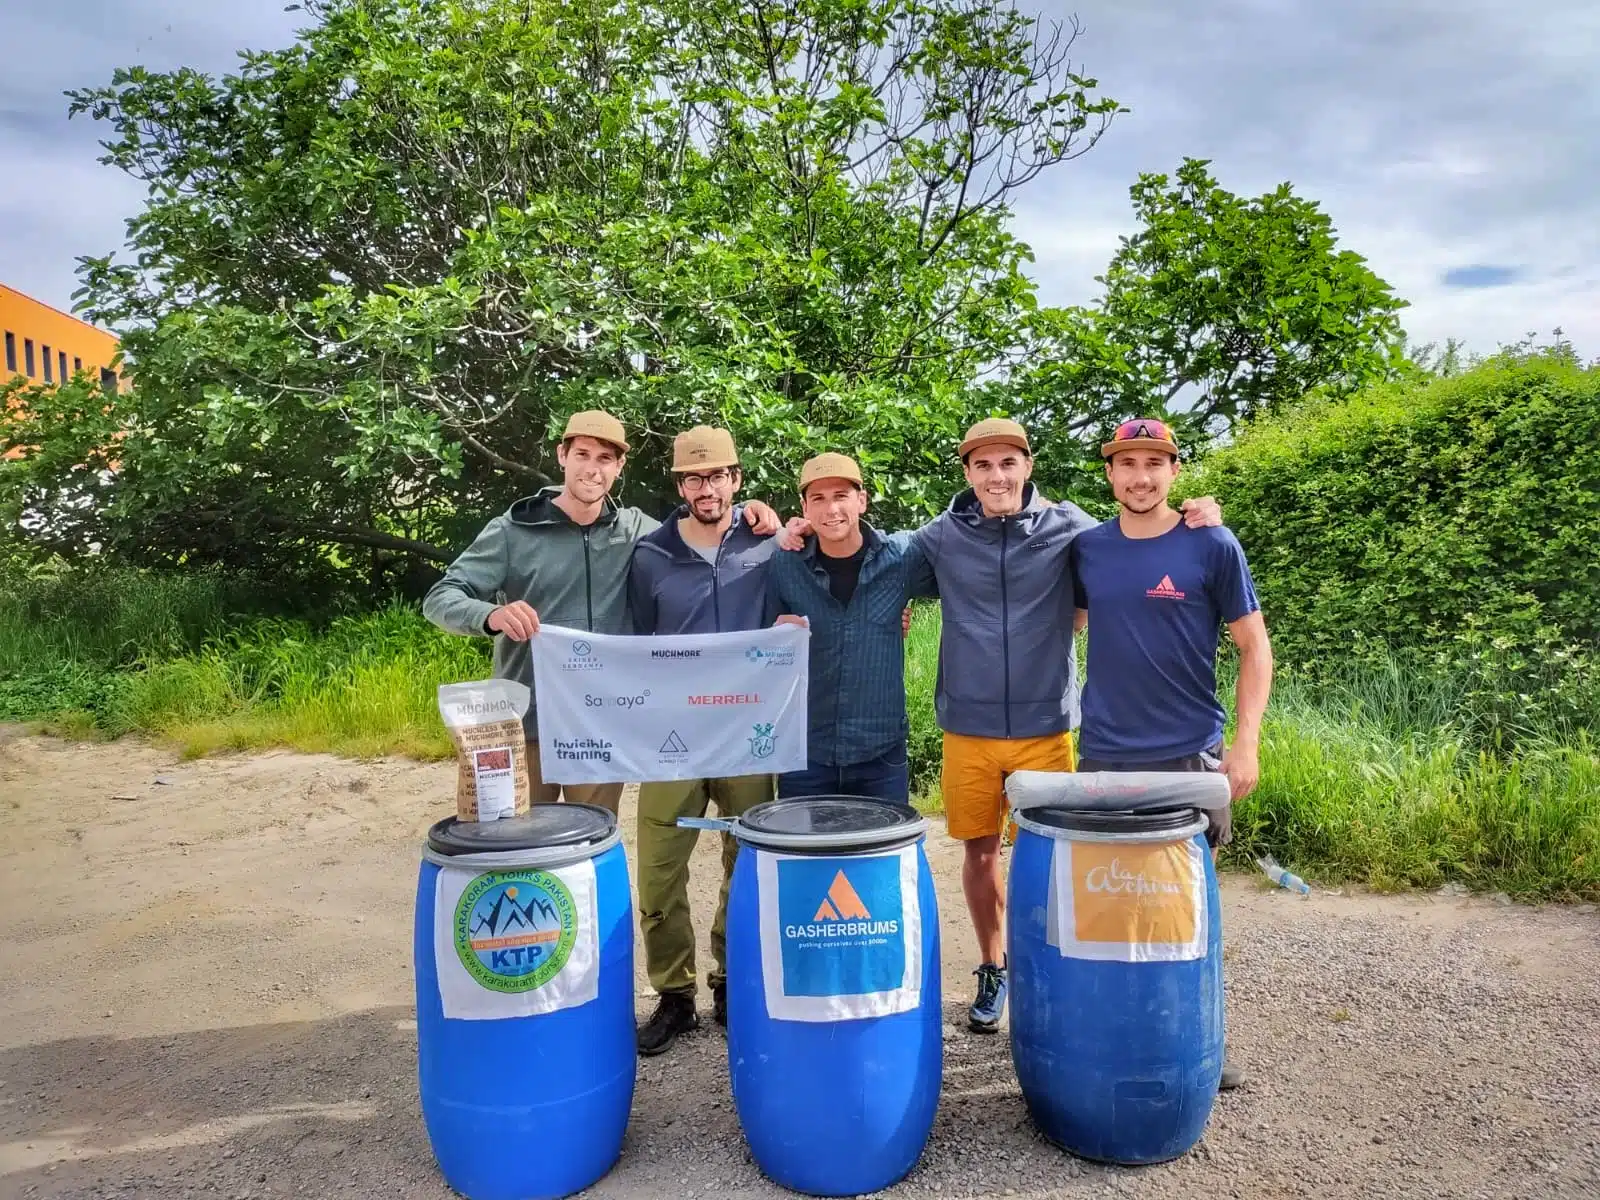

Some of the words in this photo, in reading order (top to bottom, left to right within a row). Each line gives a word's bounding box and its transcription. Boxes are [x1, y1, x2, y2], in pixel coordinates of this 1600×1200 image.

[651, 649, 701, 658] MUCHMORE
[688, 692, 761, 705] MERRELL
[556, 748, 611, 762] training
[458, 875, 497, 943] KARAKORAM
[501, 871, 541, 883] TOURS
[543, 877, 573, 930] PAKISTAN
[785, 920, 898, 938] GASHERBRUMS
[491, 945, 543, 969] KTP
